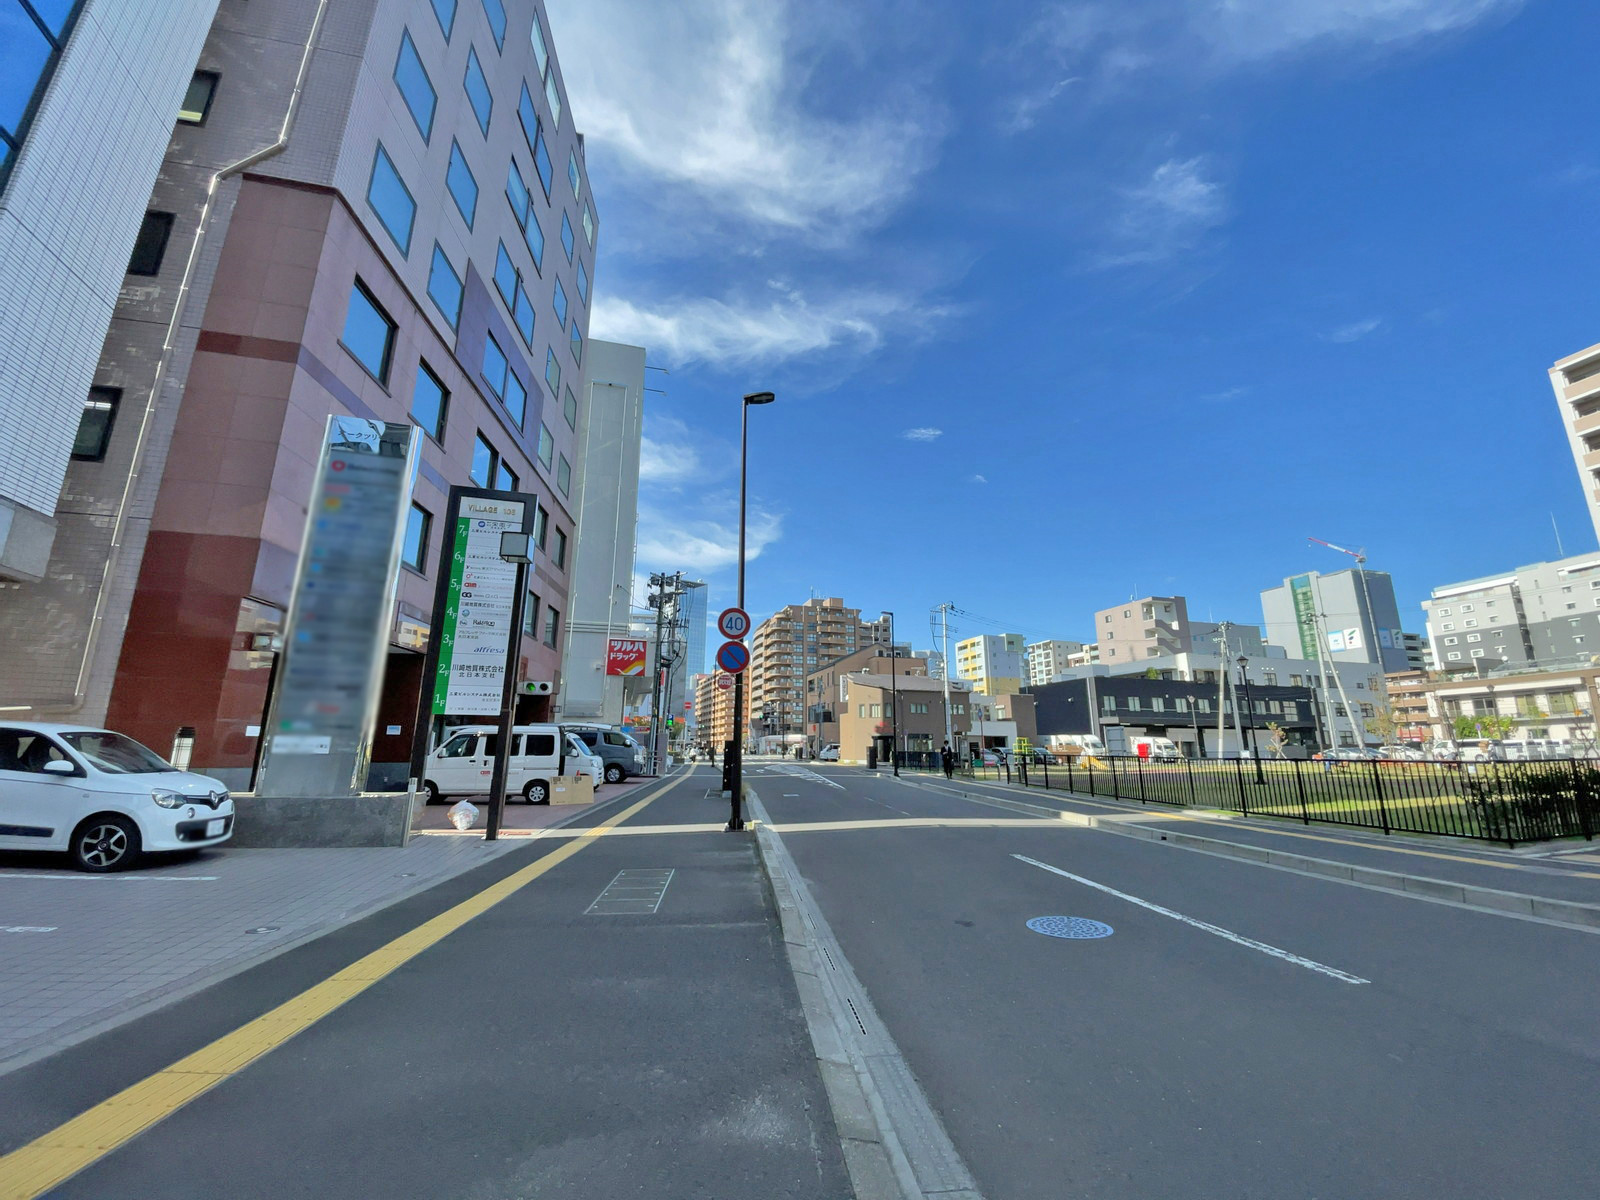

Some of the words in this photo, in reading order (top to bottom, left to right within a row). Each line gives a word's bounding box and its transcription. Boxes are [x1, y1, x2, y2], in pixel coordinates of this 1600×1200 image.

[468, 504, 498, 514] VILLAGE
[459, 525, 468, 537] 7F
[454, 551, 465, 563] 6F
[450, 579, 461, 591] 5F
[446, 606, 457, 619] 4F
[725, 617, 744, 631] 40
[443, 634, 454, 647] 3F
[611, 640, 645, 652] ツルハ
[473, 646, 505, 654] alfresa
[610, 652, 638, 661] ドラッグ
[439, 663, 449, 676] 2F
[435, 693, 446, 707] 1F
